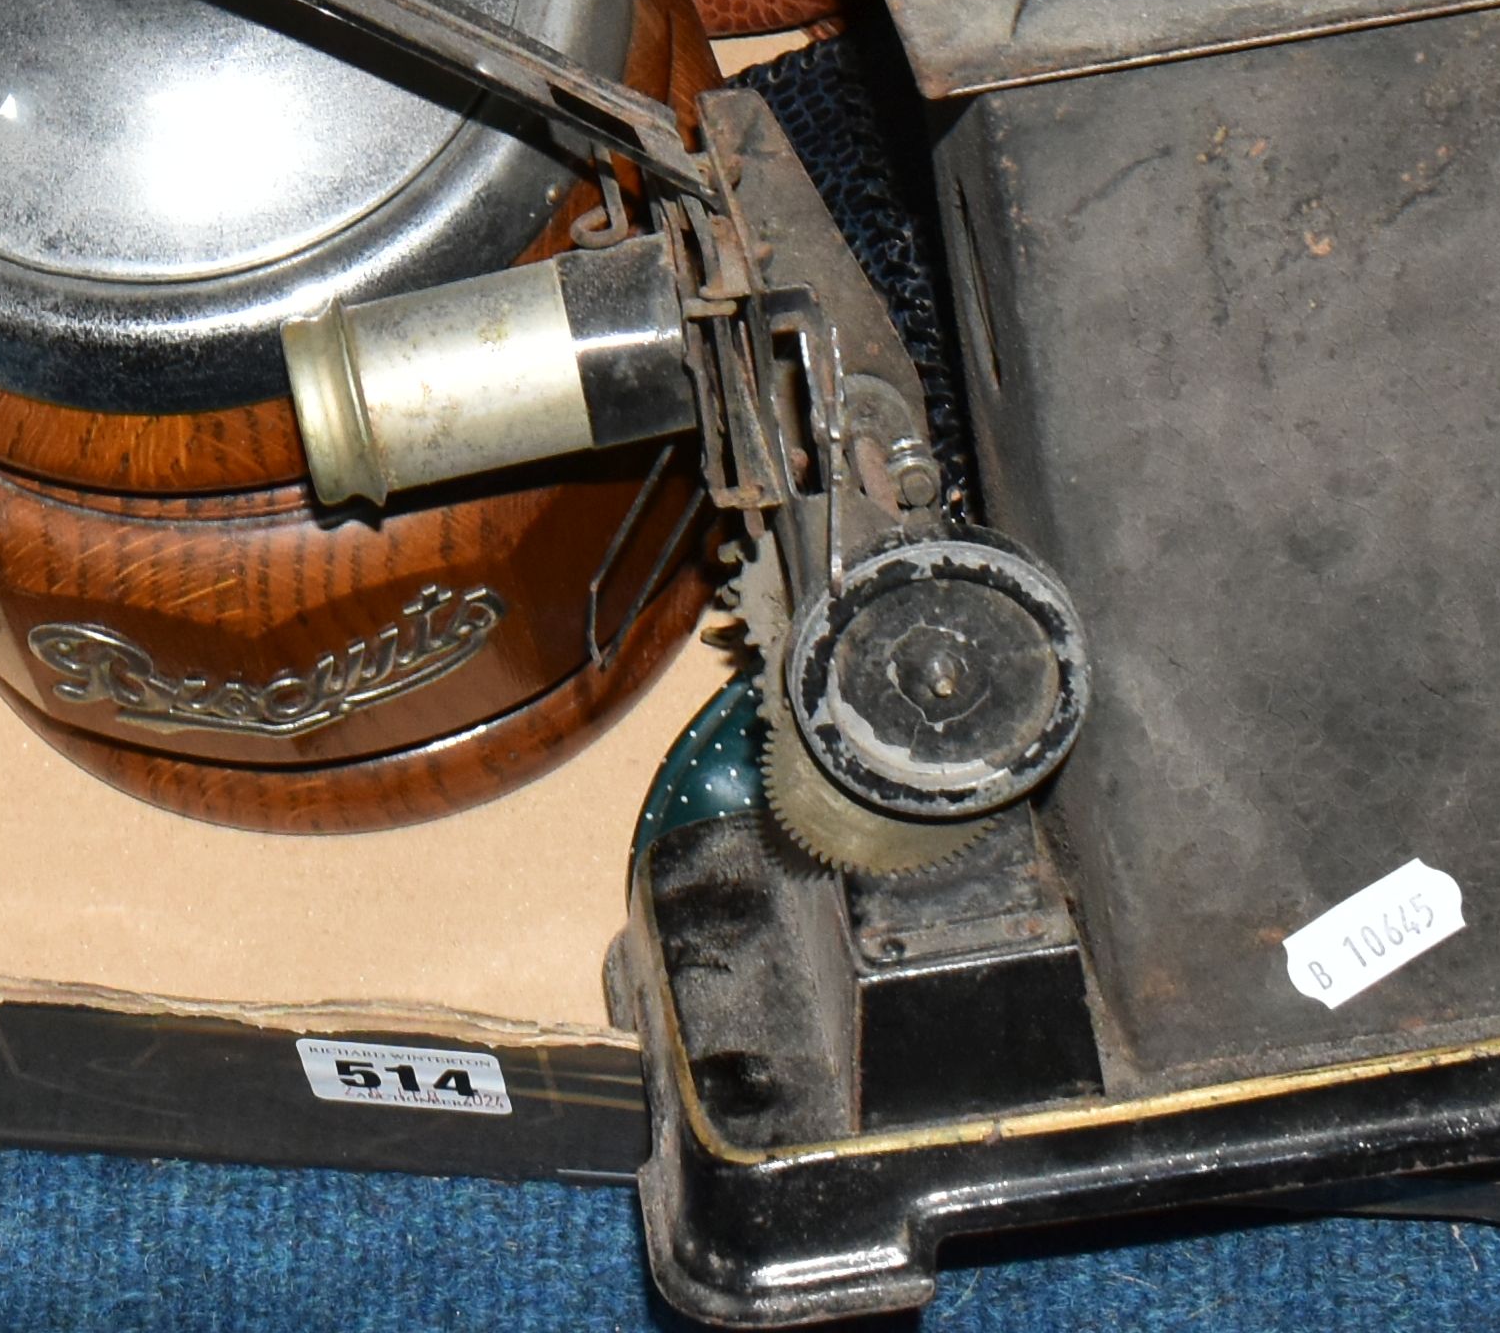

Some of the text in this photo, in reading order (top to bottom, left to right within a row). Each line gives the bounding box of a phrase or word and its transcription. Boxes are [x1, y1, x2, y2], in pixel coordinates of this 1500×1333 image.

[1307, 892, 1435, 990] B 10645
[308, 1044, 491, 1068] RICHARD WINTERTON
[334, 1059, 479, 1097] 514
